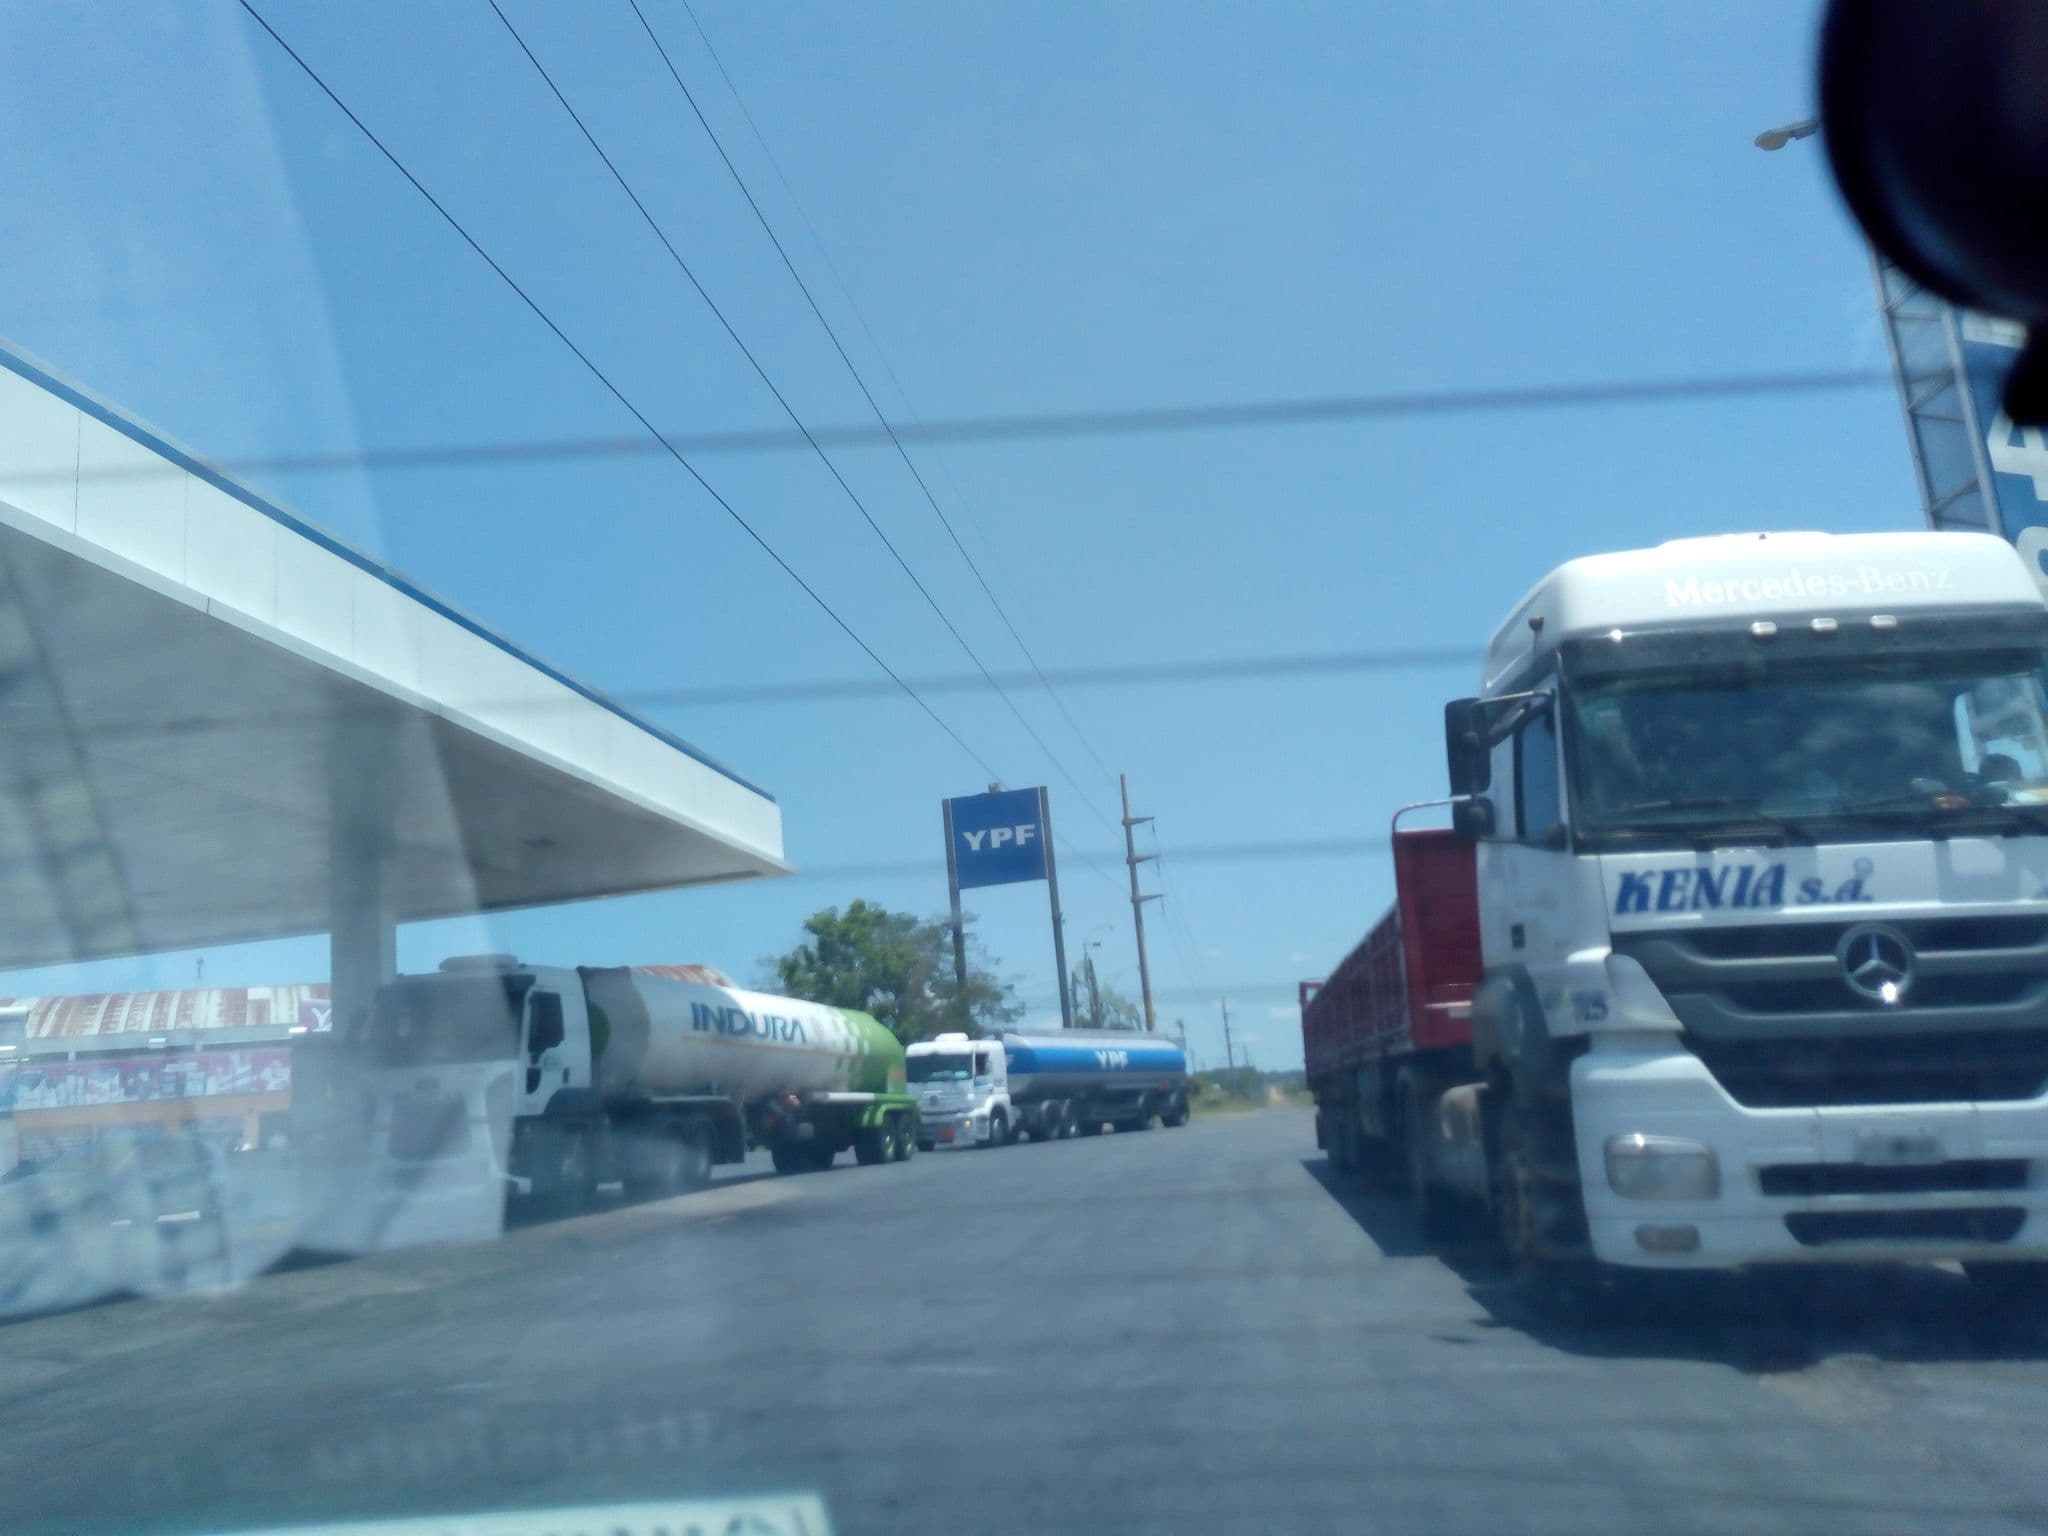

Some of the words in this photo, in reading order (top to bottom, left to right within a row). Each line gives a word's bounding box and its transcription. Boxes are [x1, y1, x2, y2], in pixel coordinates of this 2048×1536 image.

[1663, 564, 1953, 608] Mercedes-Benz
[963, 823, 1036, 851] YPF
[1615, 863, 1787, 916] KENIA
[690, 1001, 807, 1043] INDURA
